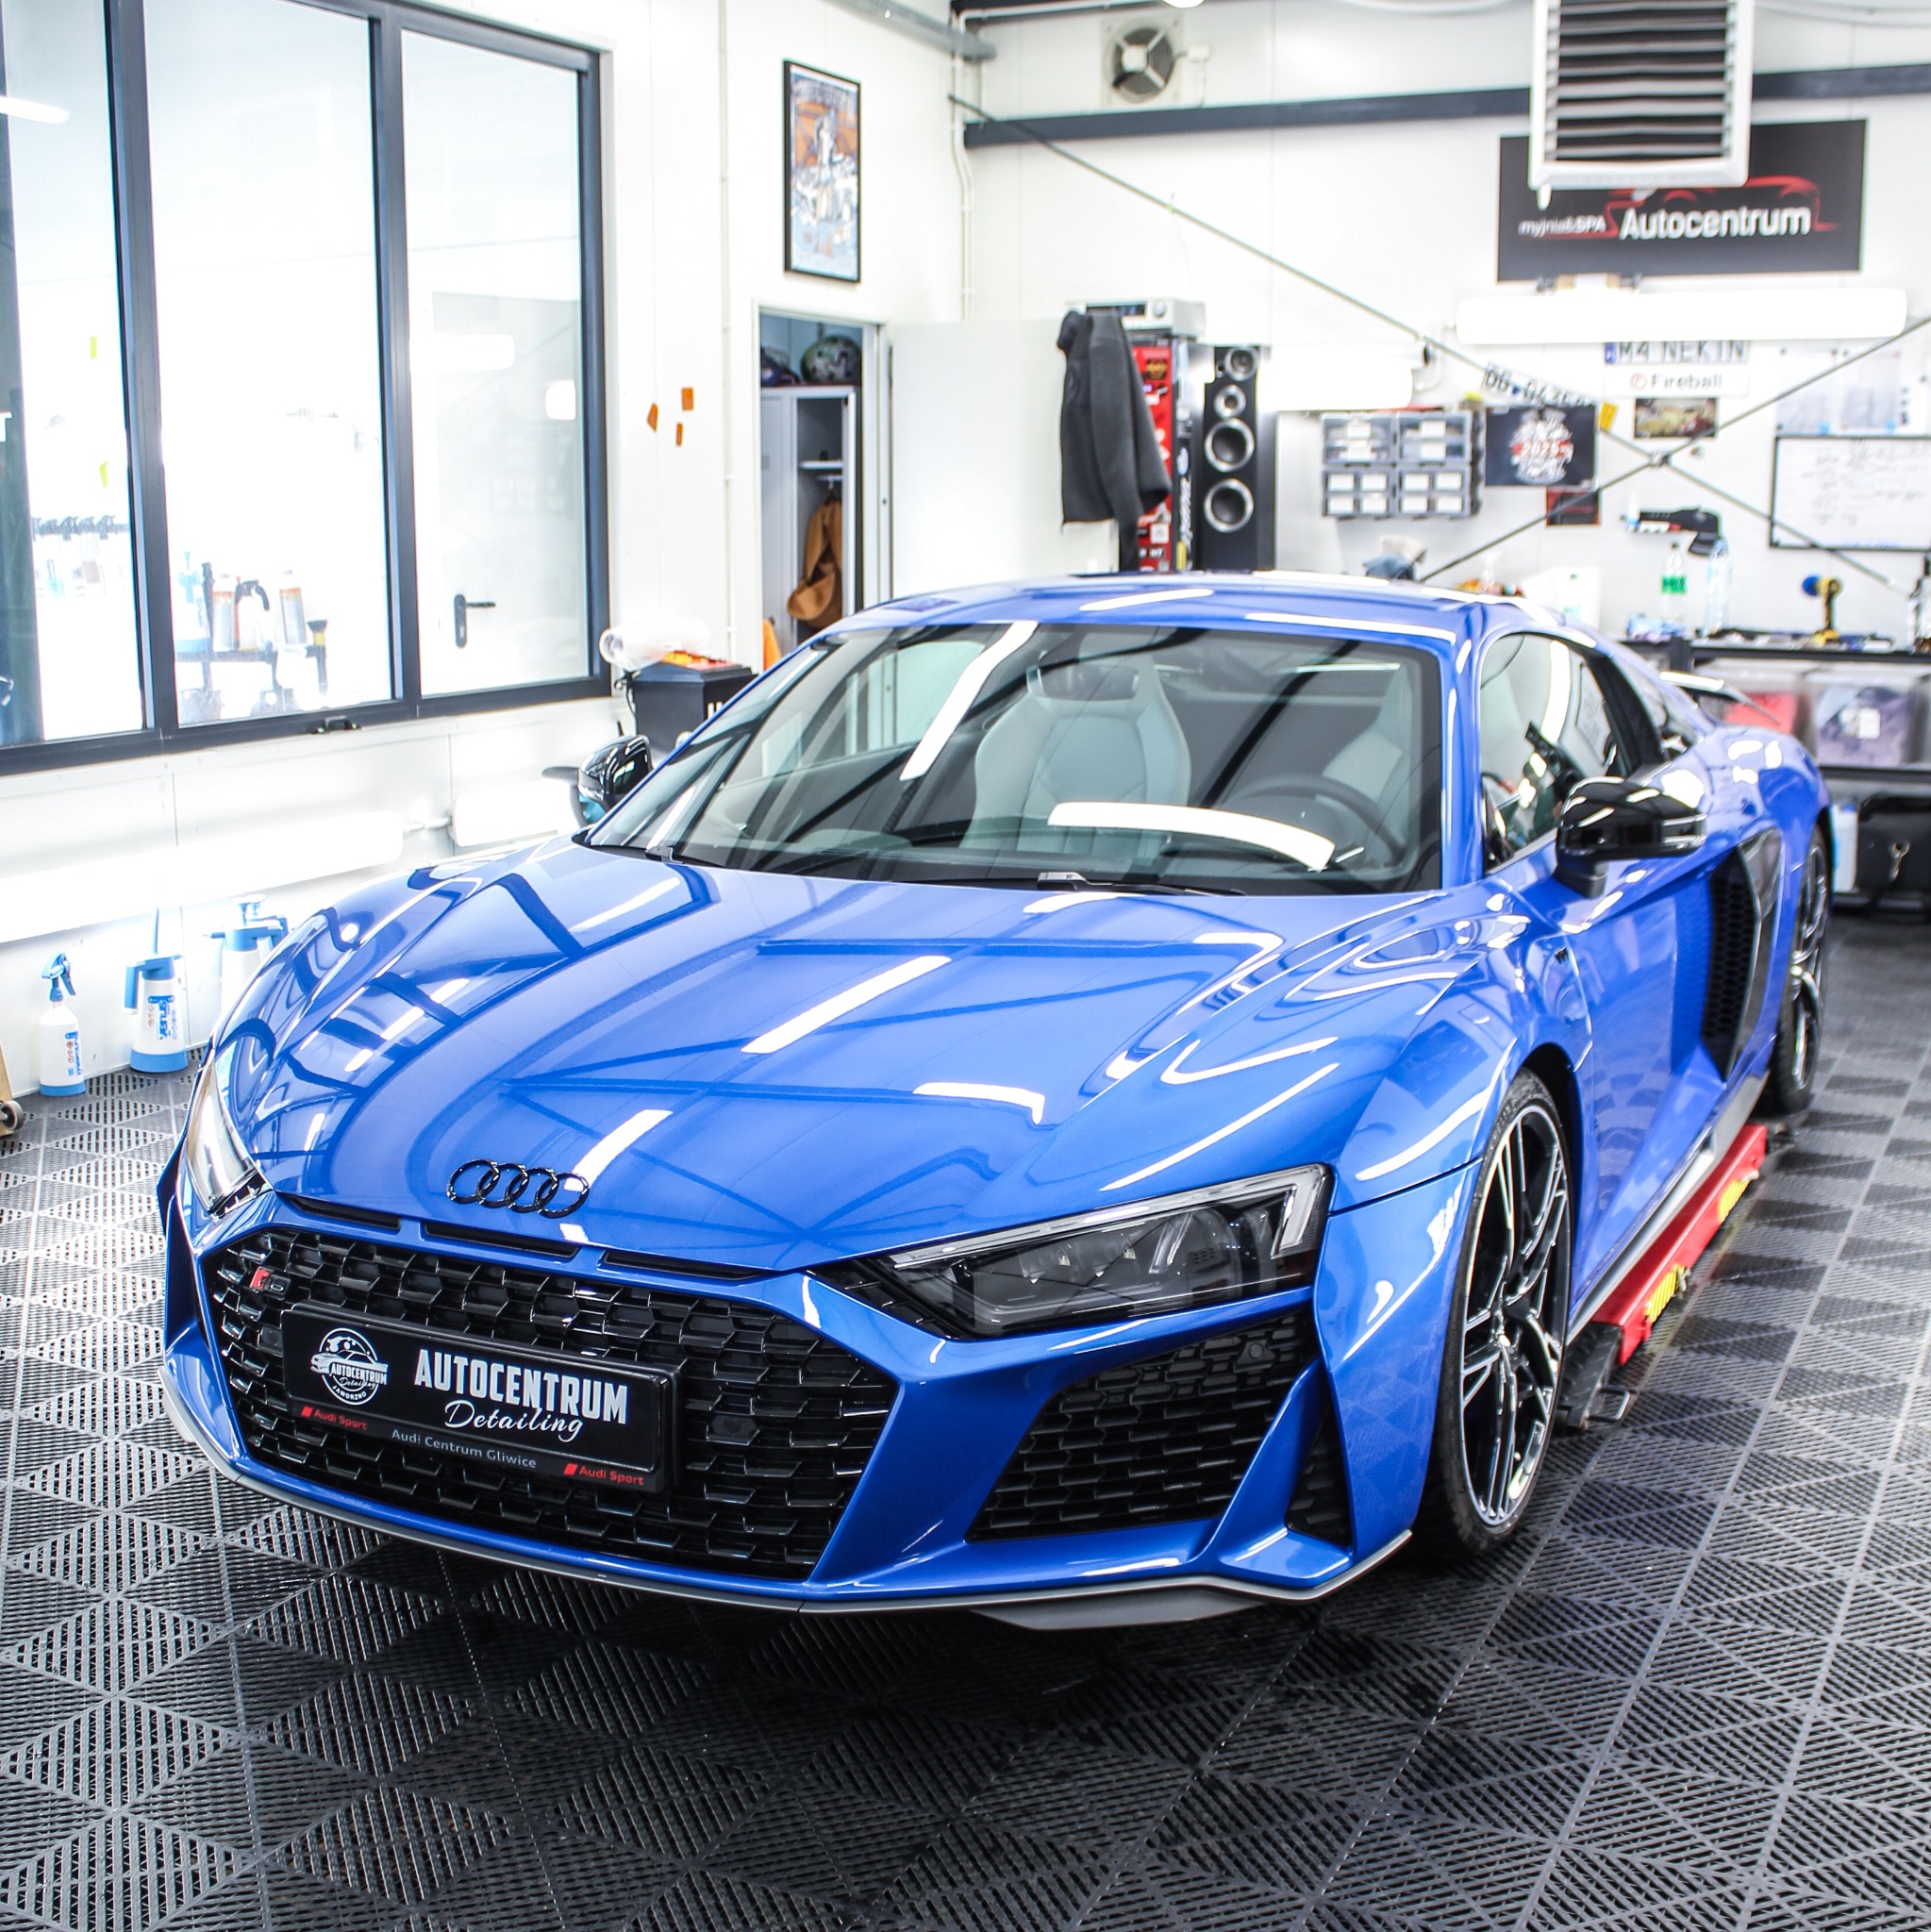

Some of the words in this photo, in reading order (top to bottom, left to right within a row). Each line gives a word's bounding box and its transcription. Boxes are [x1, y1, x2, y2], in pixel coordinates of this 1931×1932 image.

[1619, 206, 1811, 240] Autocentrum
[1651, 372, 1723, 391] Fireball
[330, 1363, 388, 1386] AUTOCENTRUM
[339, 1377, 376, 1390] Detailing
[332, 1385, 367, 1401] JAWORZNO
[413, 1348, 628, 1425] AUTOCENTRUM
[314, 1409, 337, 1423] Audi
[339, 1415, 367, 1431] Sport
[444, 1399, 584, 1443] Detailing
[391, 1429, 421, 1445] Audi
[424, 1436, 483, 1457] Centrum
[486, 1450, 537, 1469] Gliwice
[579, 1466, 607, 1479] Audi
[609, 1471, 644, 1487] Sport
